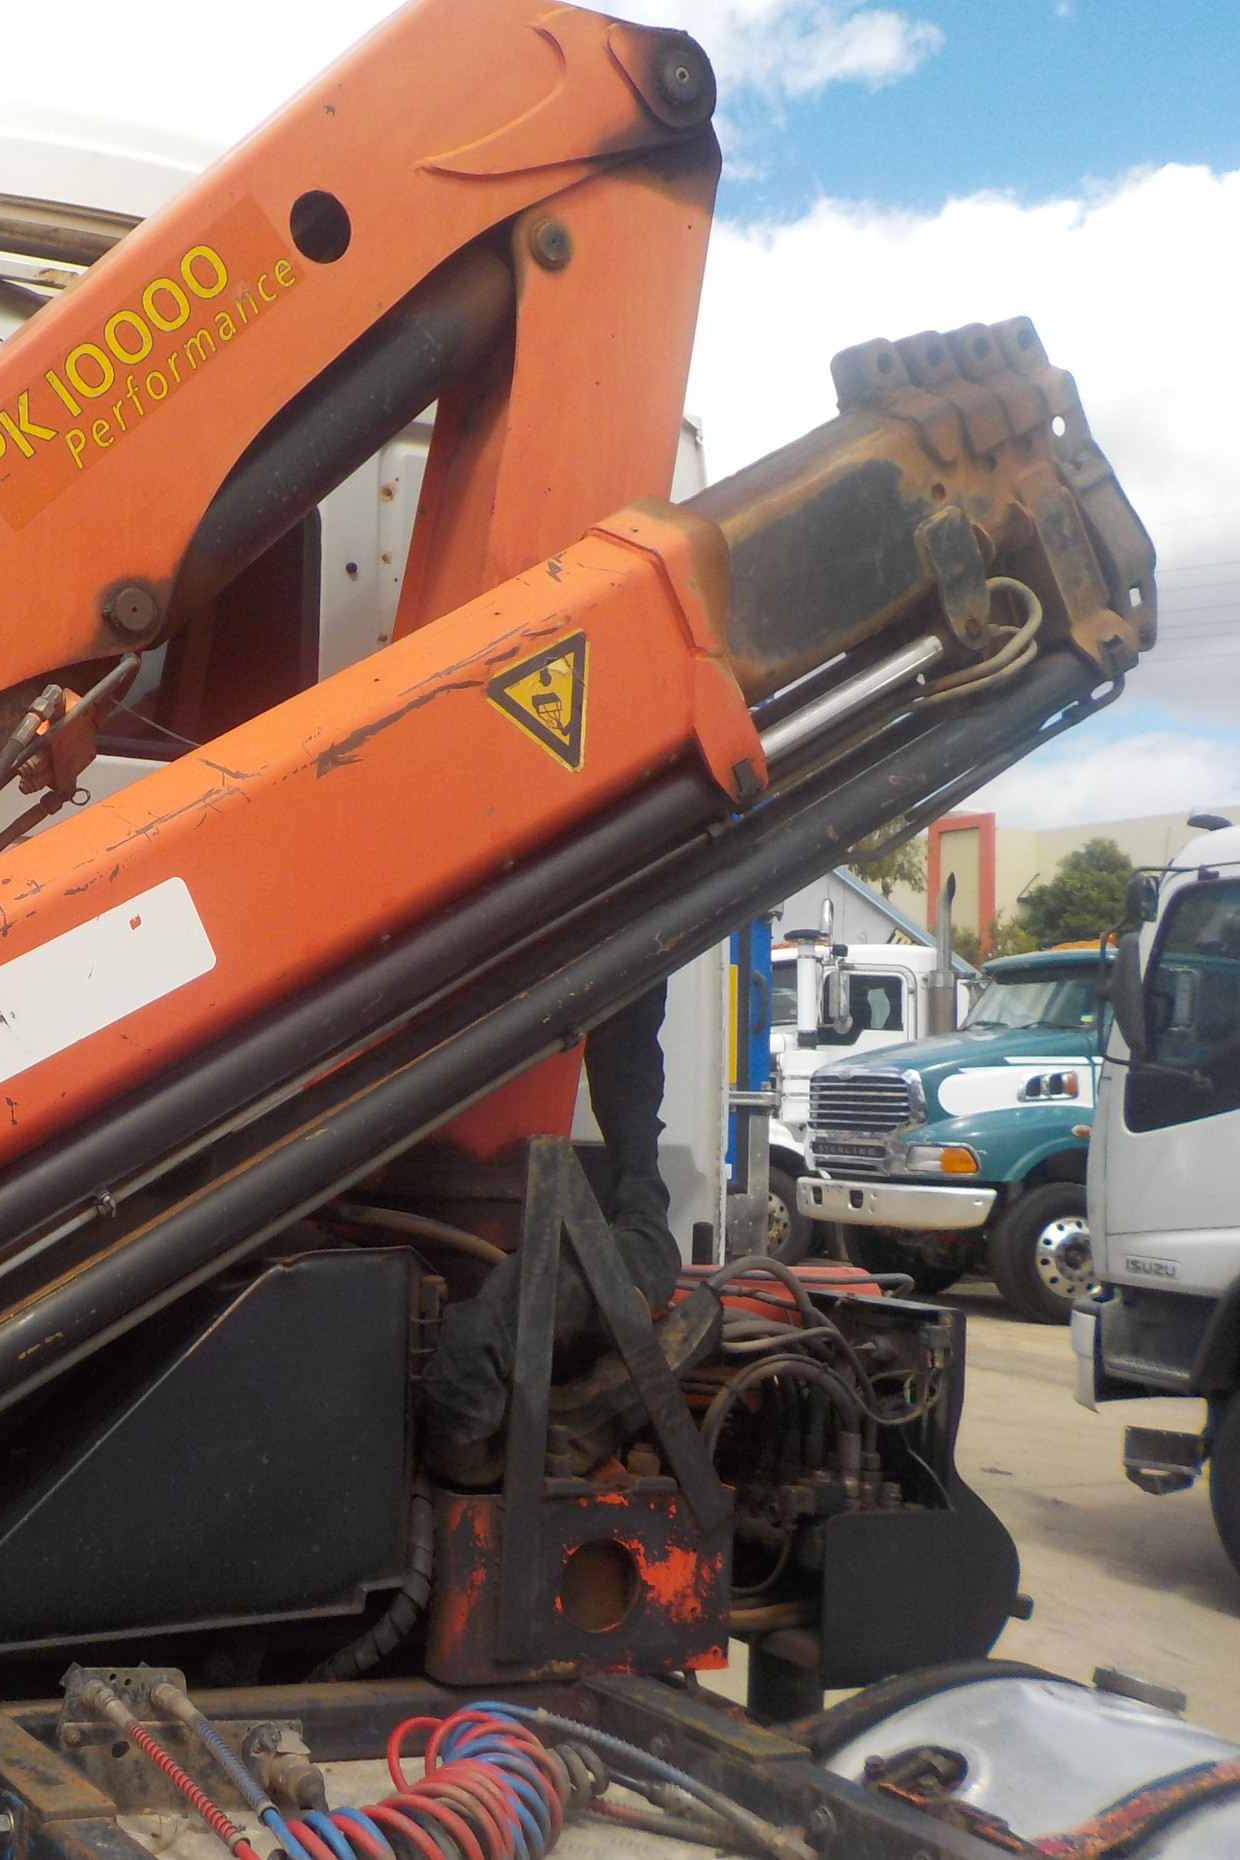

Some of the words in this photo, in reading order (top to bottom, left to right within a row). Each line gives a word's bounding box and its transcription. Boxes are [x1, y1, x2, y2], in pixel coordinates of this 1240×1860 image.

[44, 244, 229, 418] 10000
[63, 257, 297, 470] Performance
[818, 1144, 876, 1157] STERLING
[1125, 1259, 1176, 1278] ISUZU
